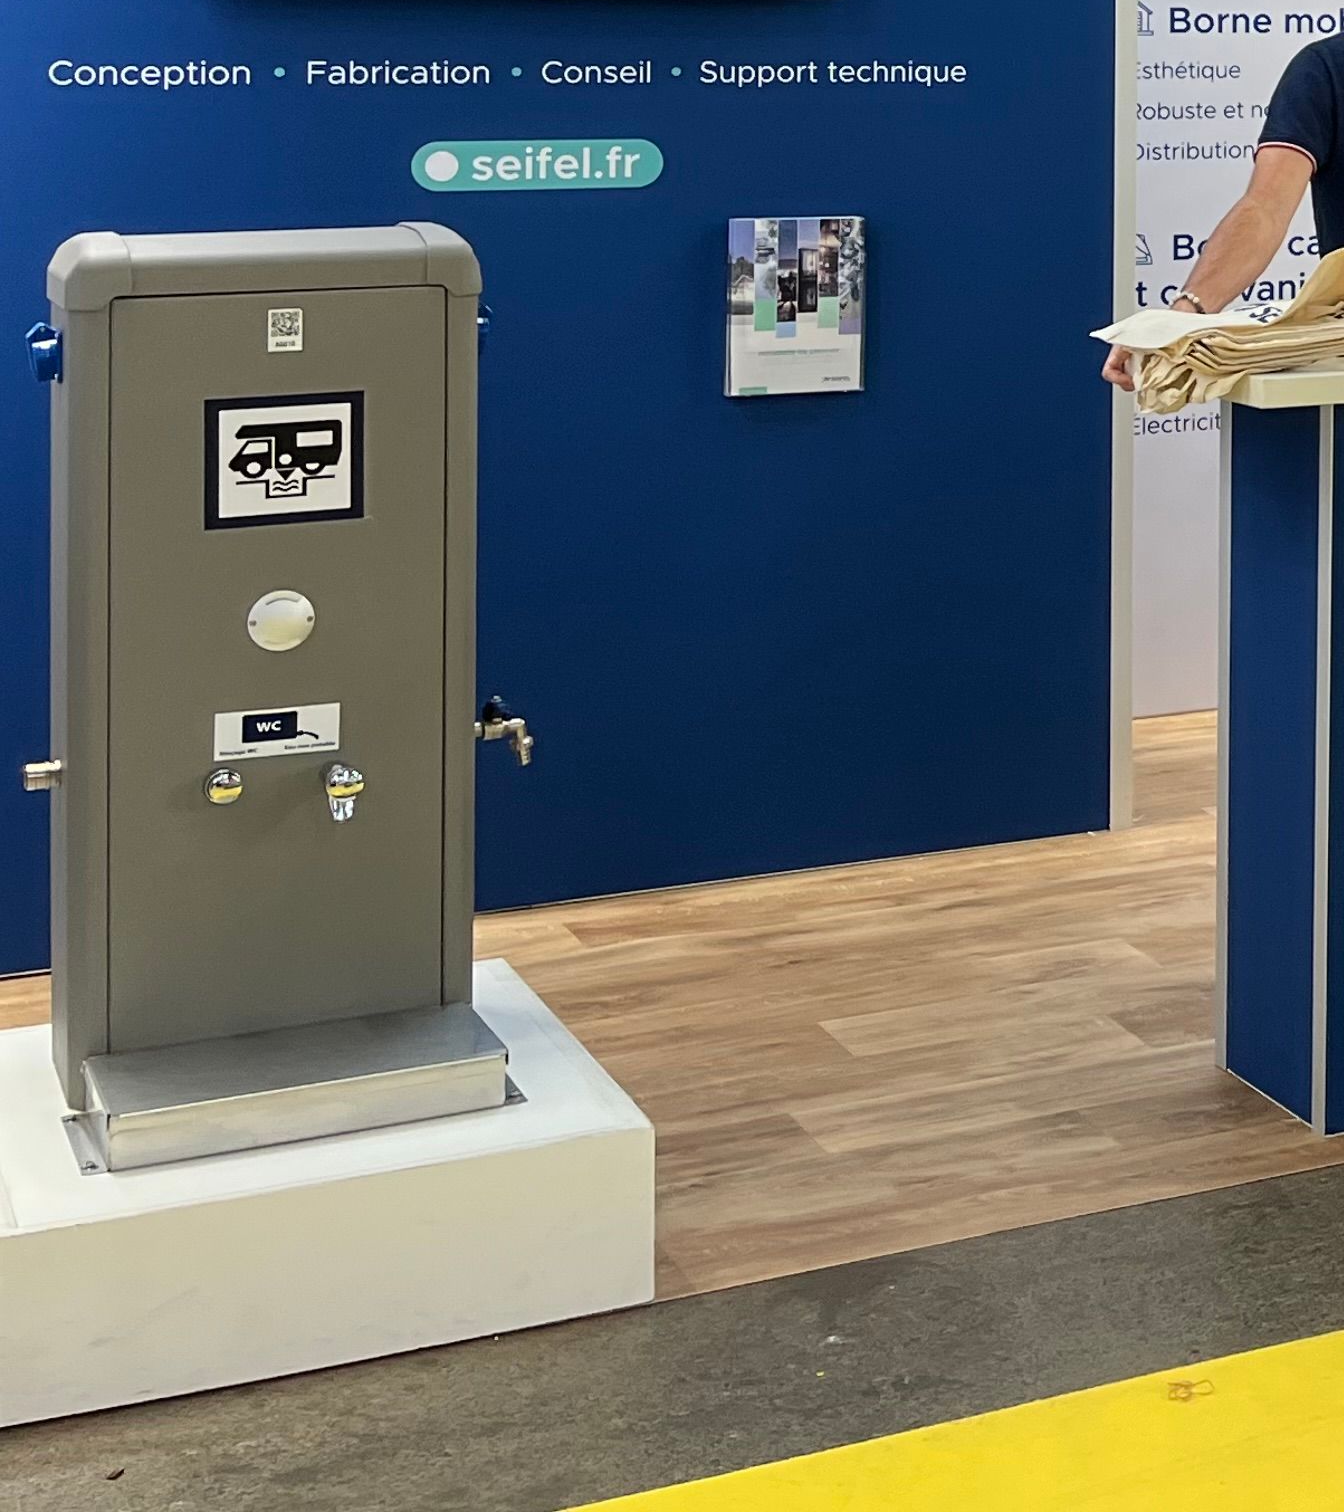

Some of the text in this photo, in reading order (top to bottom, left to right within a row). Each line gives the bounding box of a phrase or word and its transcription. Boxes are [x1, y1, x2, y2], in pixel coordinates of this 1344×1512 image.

[1169, 6, 1272, 34] Borne
[48, 59, 967, 90] Conception Fabrication Conseil Support technique
[1223, 102, 1244, 119] et
[471, 145, 641, 182] seifel.fr
[255, 719, 282, 733] WC
